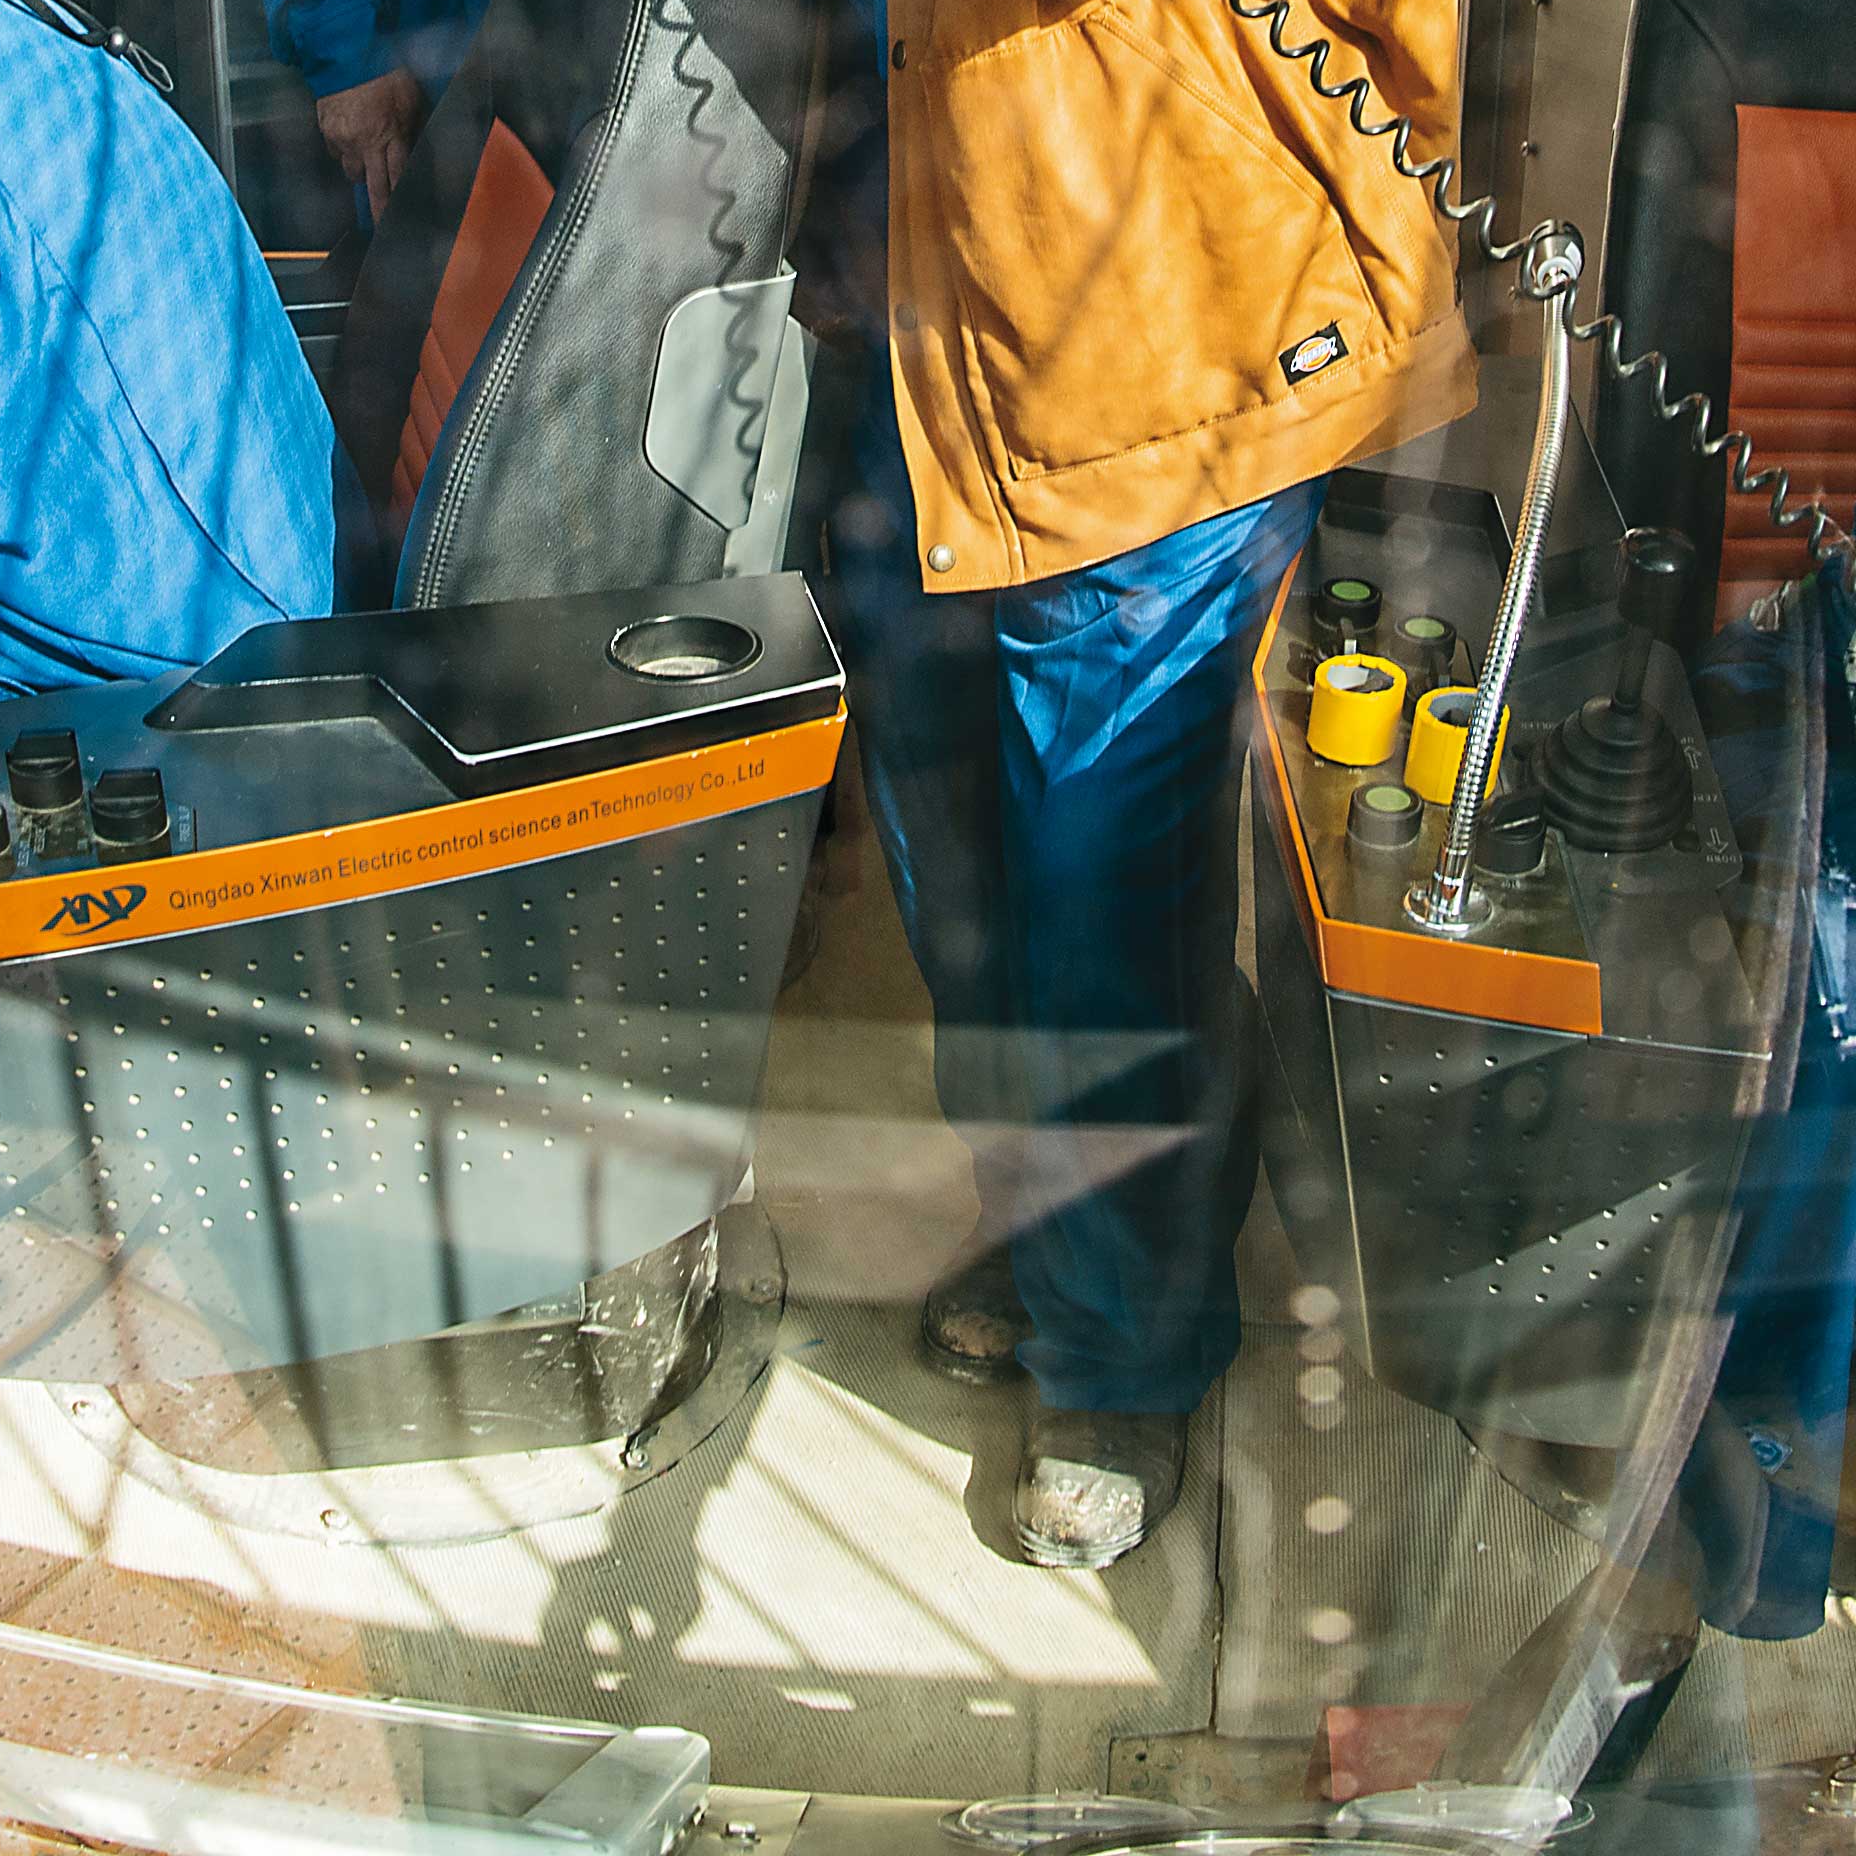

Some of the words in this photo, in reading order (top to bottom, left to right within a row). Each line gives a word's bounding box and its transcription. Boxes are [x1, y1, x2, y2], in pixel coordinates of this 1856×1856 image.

[168, 881, 254, 911] Qingdao
[260, 867, 333, 893] Xinwan
[338, 847, 413, 879] Electric
[417, 828, 484, 862] control
[488, 813, 562, 845] science
